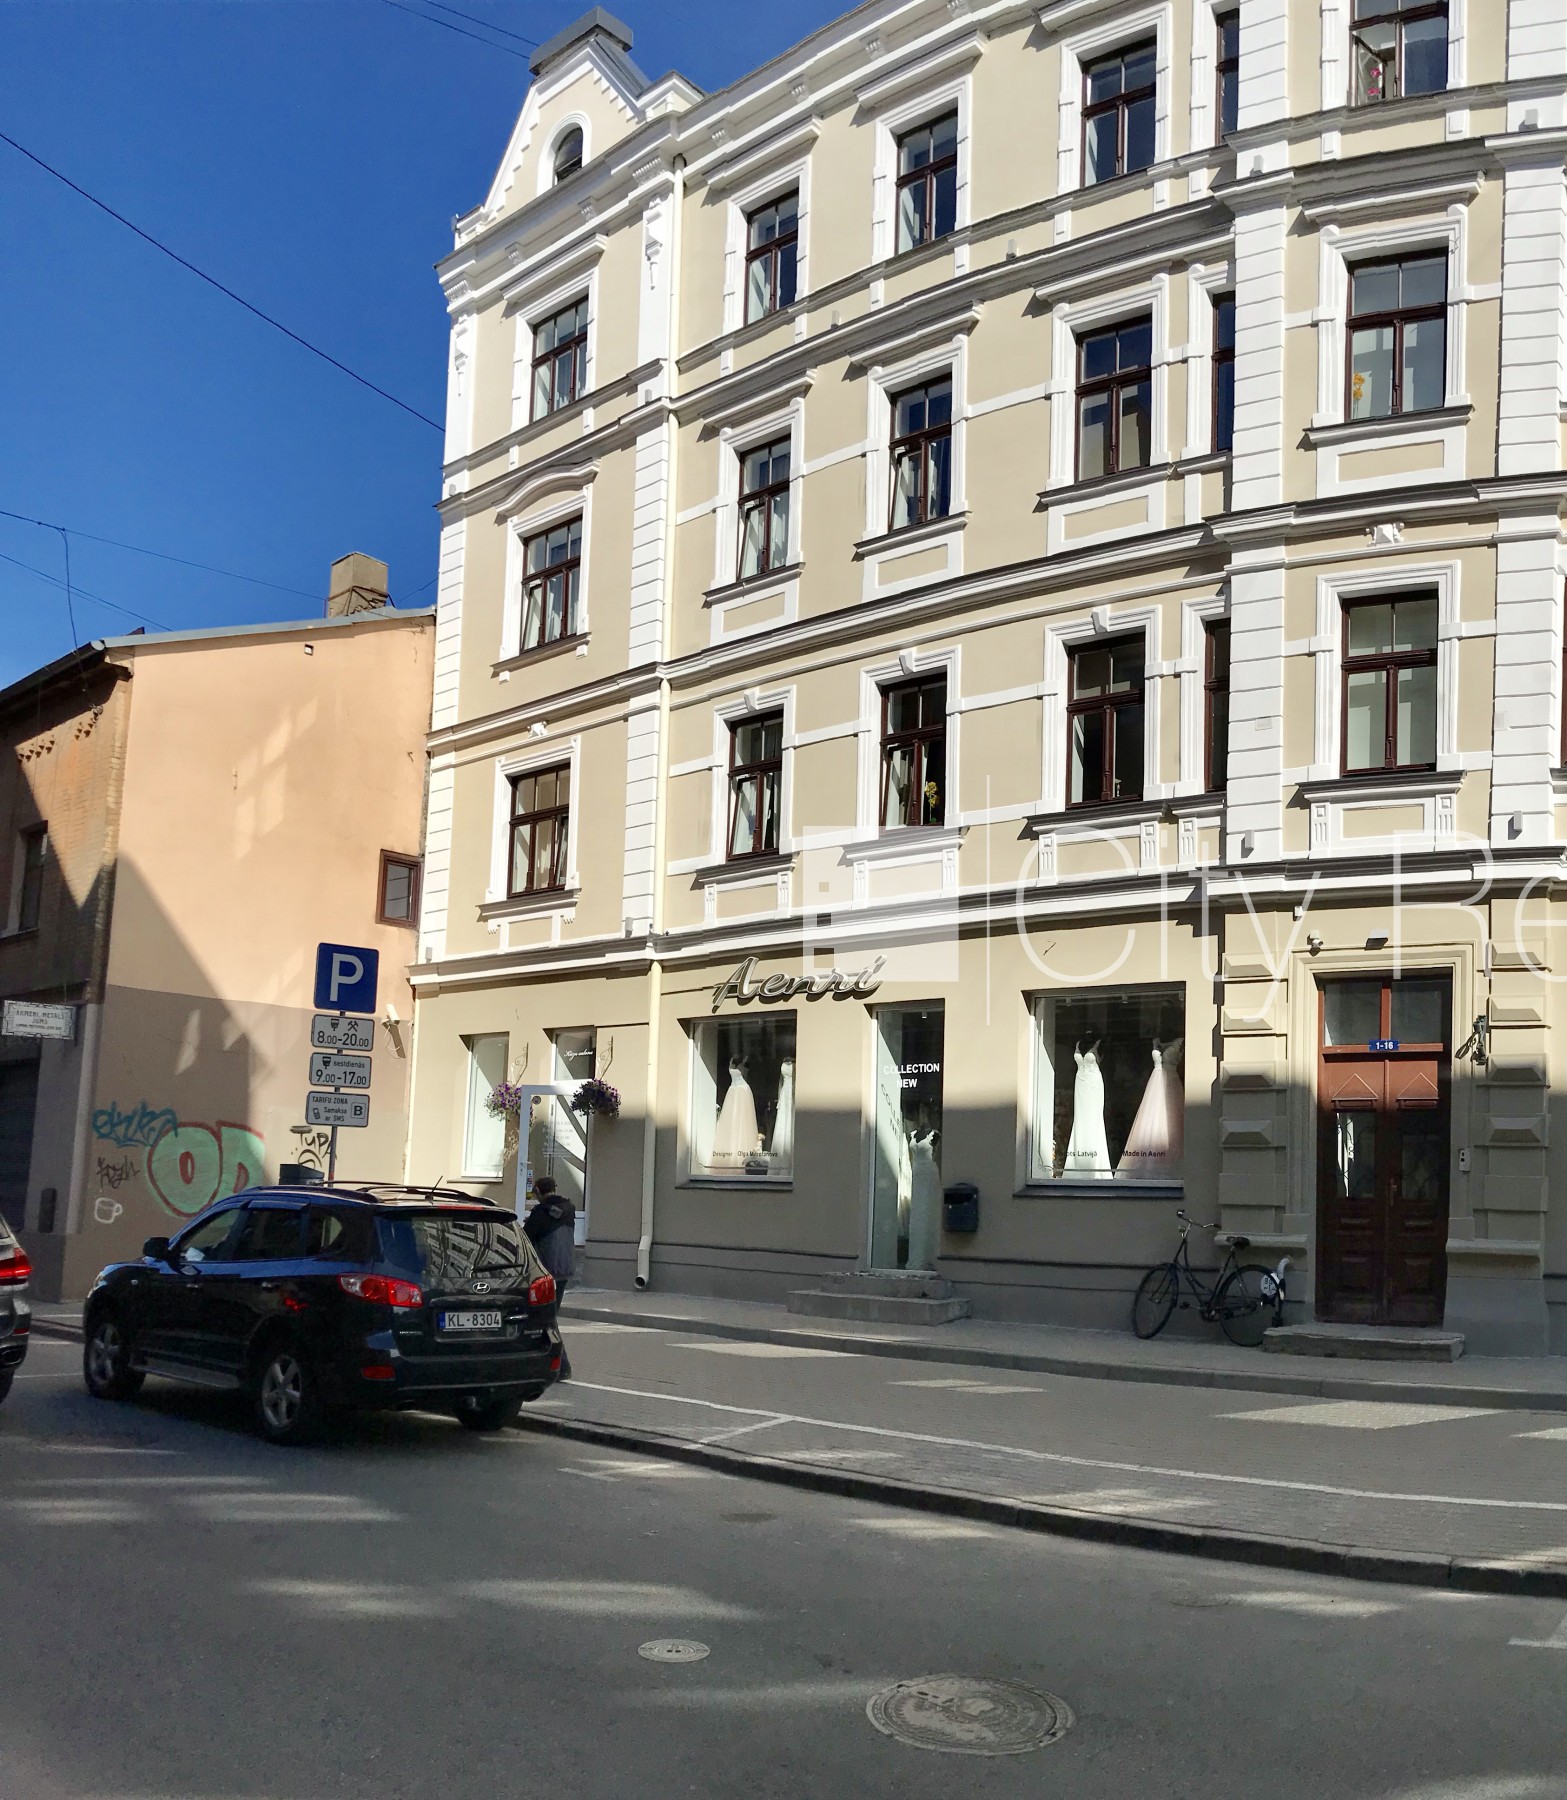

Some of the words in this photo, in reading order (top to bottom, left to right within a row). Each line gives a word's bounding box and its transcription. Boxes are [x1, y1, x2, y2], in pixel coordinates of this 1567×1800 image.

[329, 952, 364, 1001] P
[712, 955, 888, 1010] Aenri
[1376, 1041, 1394, 1050] 1-16
[883, 1063, 940, 1075] COLLECTION
[897, 1078, 918, 1088] NEW
[353, 1105, 363, 1116] B
[448, 1313, 500, 1327] KL-8304
